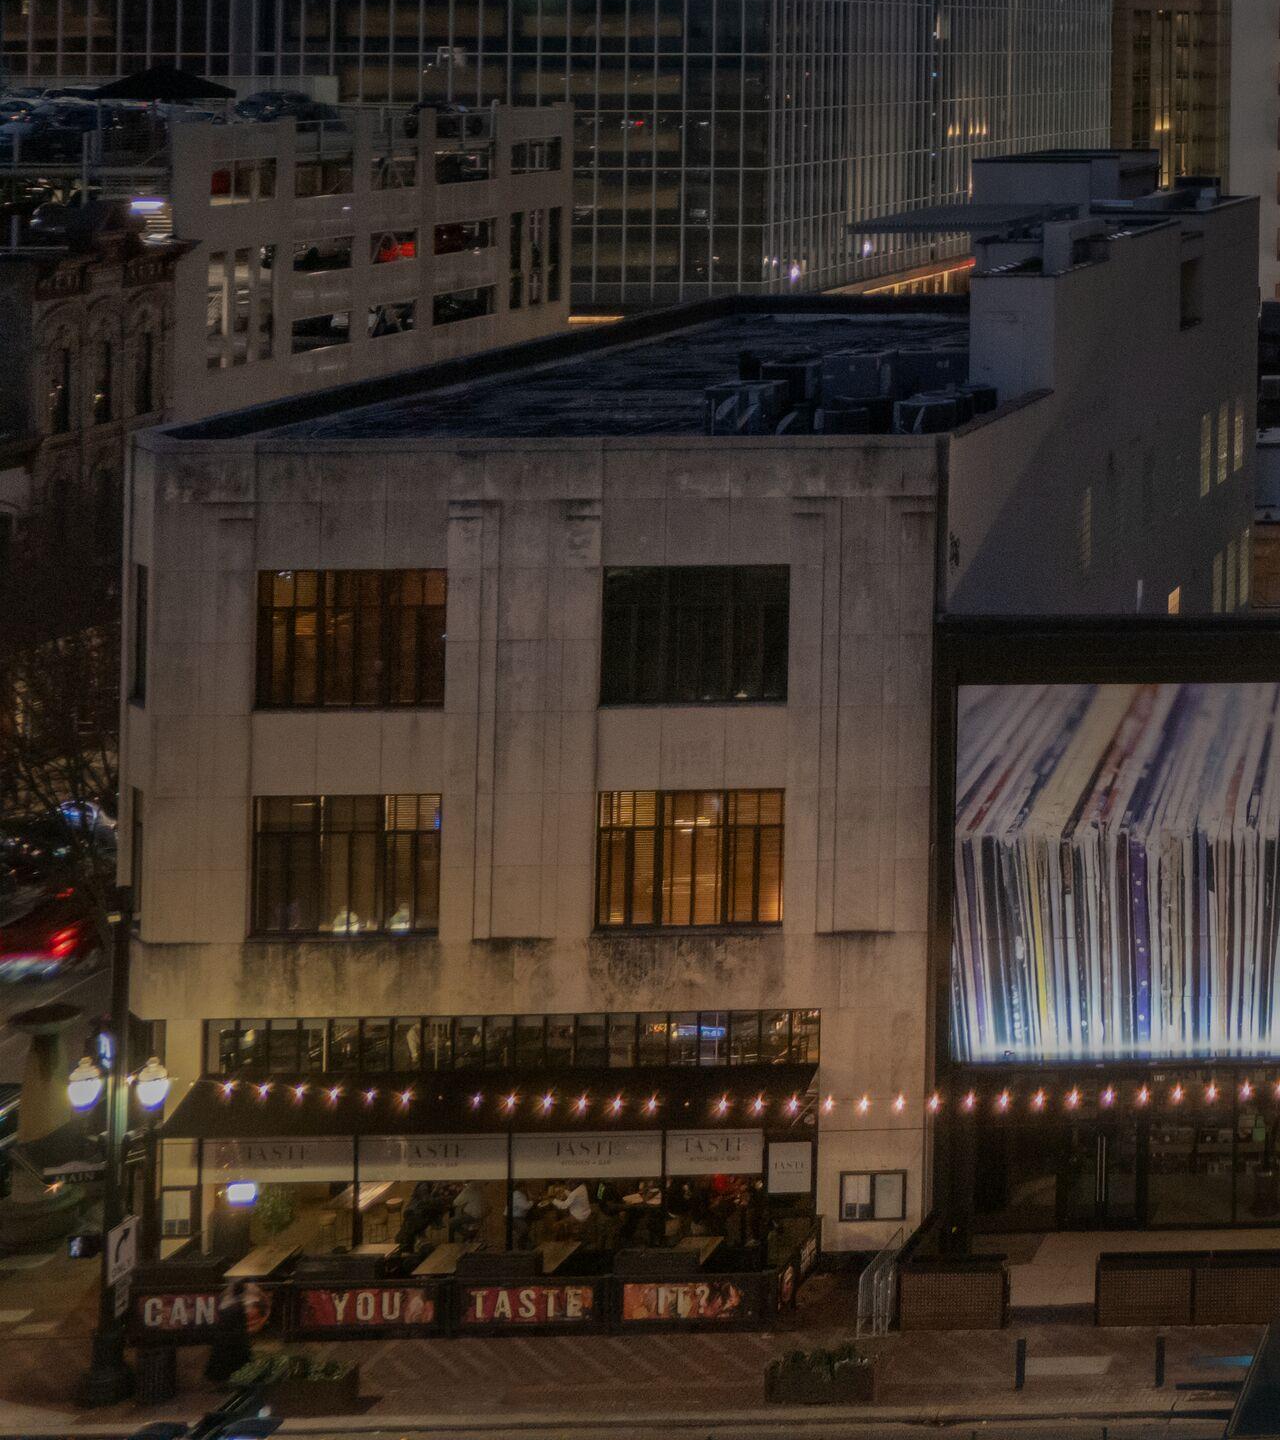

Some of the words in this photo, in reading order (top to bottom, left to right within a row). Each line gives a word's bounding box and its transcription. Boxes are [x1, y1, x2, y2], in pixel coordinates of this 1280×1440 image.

[553, 1141, 620, 1157] TASTE
[681, 1136, 749, 1152] TASTE
[144, 1296, 216, 1327] CAN
[331, 1291, 402, 1322] YOU
[470, 1288, 583, 1319] TASTE
[657, 1285, 711, 1318] IT?
